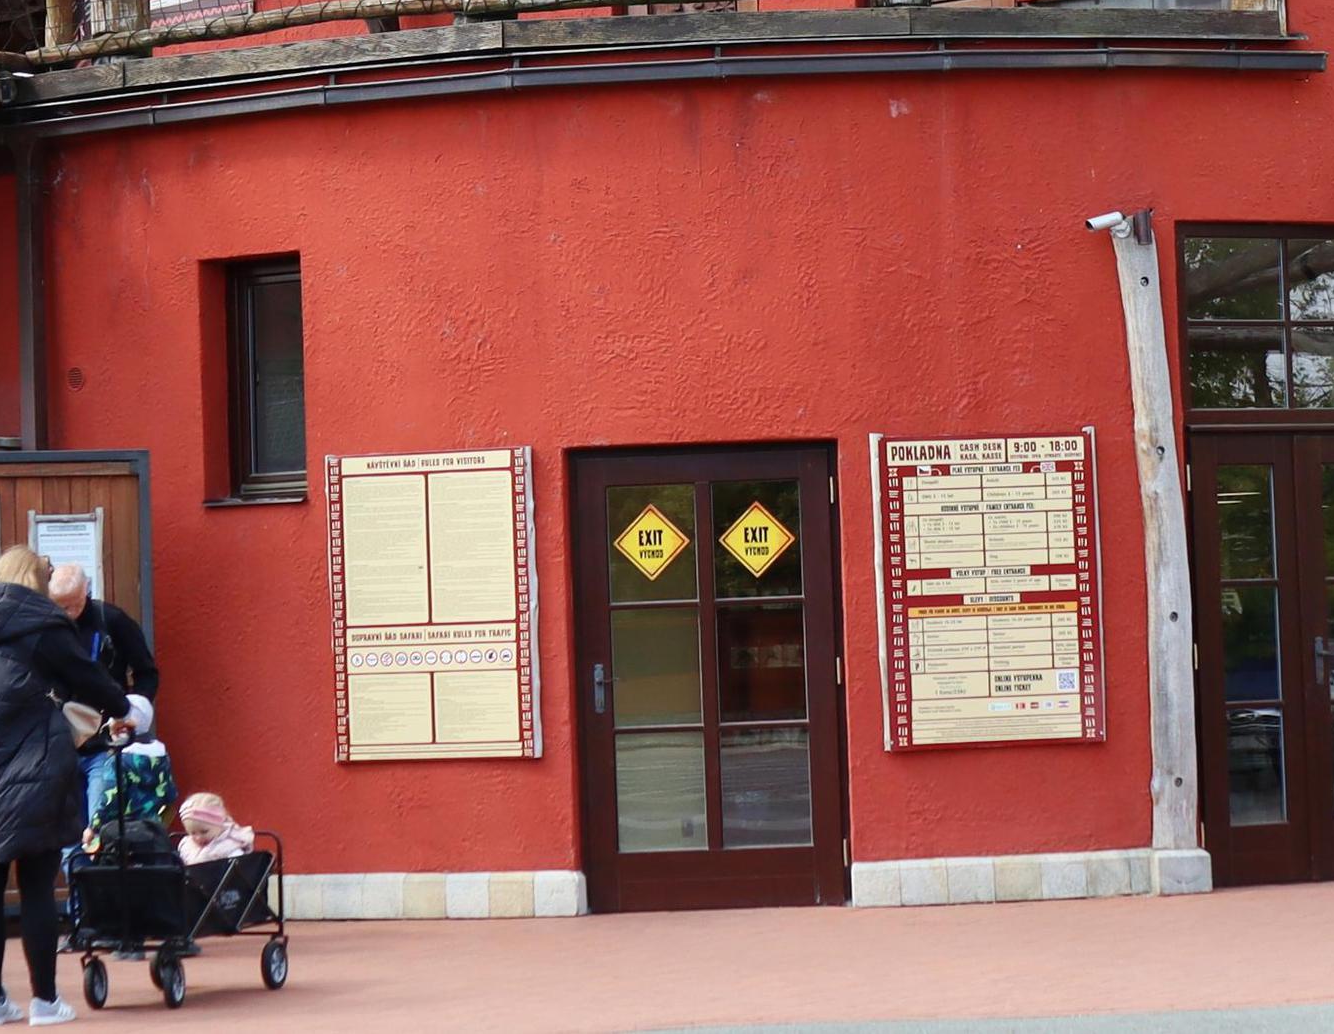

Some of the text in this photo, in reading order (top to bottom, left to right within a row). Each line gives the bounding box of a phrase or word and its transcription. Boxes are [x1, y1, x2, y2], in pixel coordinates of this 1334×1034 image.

[891, 444, 951, 462] POKLADNA
[959, 442, 1002, 452] CASH DESK
[1013, 441, 1037, 453] 9:00
[1049, 439, 1078, 451] 18:00
[421, 458, 440, 467] RULES
[442, 457, 454, 466] FOR
[456, 456, 486, 466] VISITORS
[638, 529, 664, 546] EXIT
[743, 526, 769, 543] EXIT
[399, 631, 423, 641] SAFARI
[427, 631, 451, 640] SAFARI
[453, 630, 472, 639] RULES
[474, 629, 486, 638] FOR
